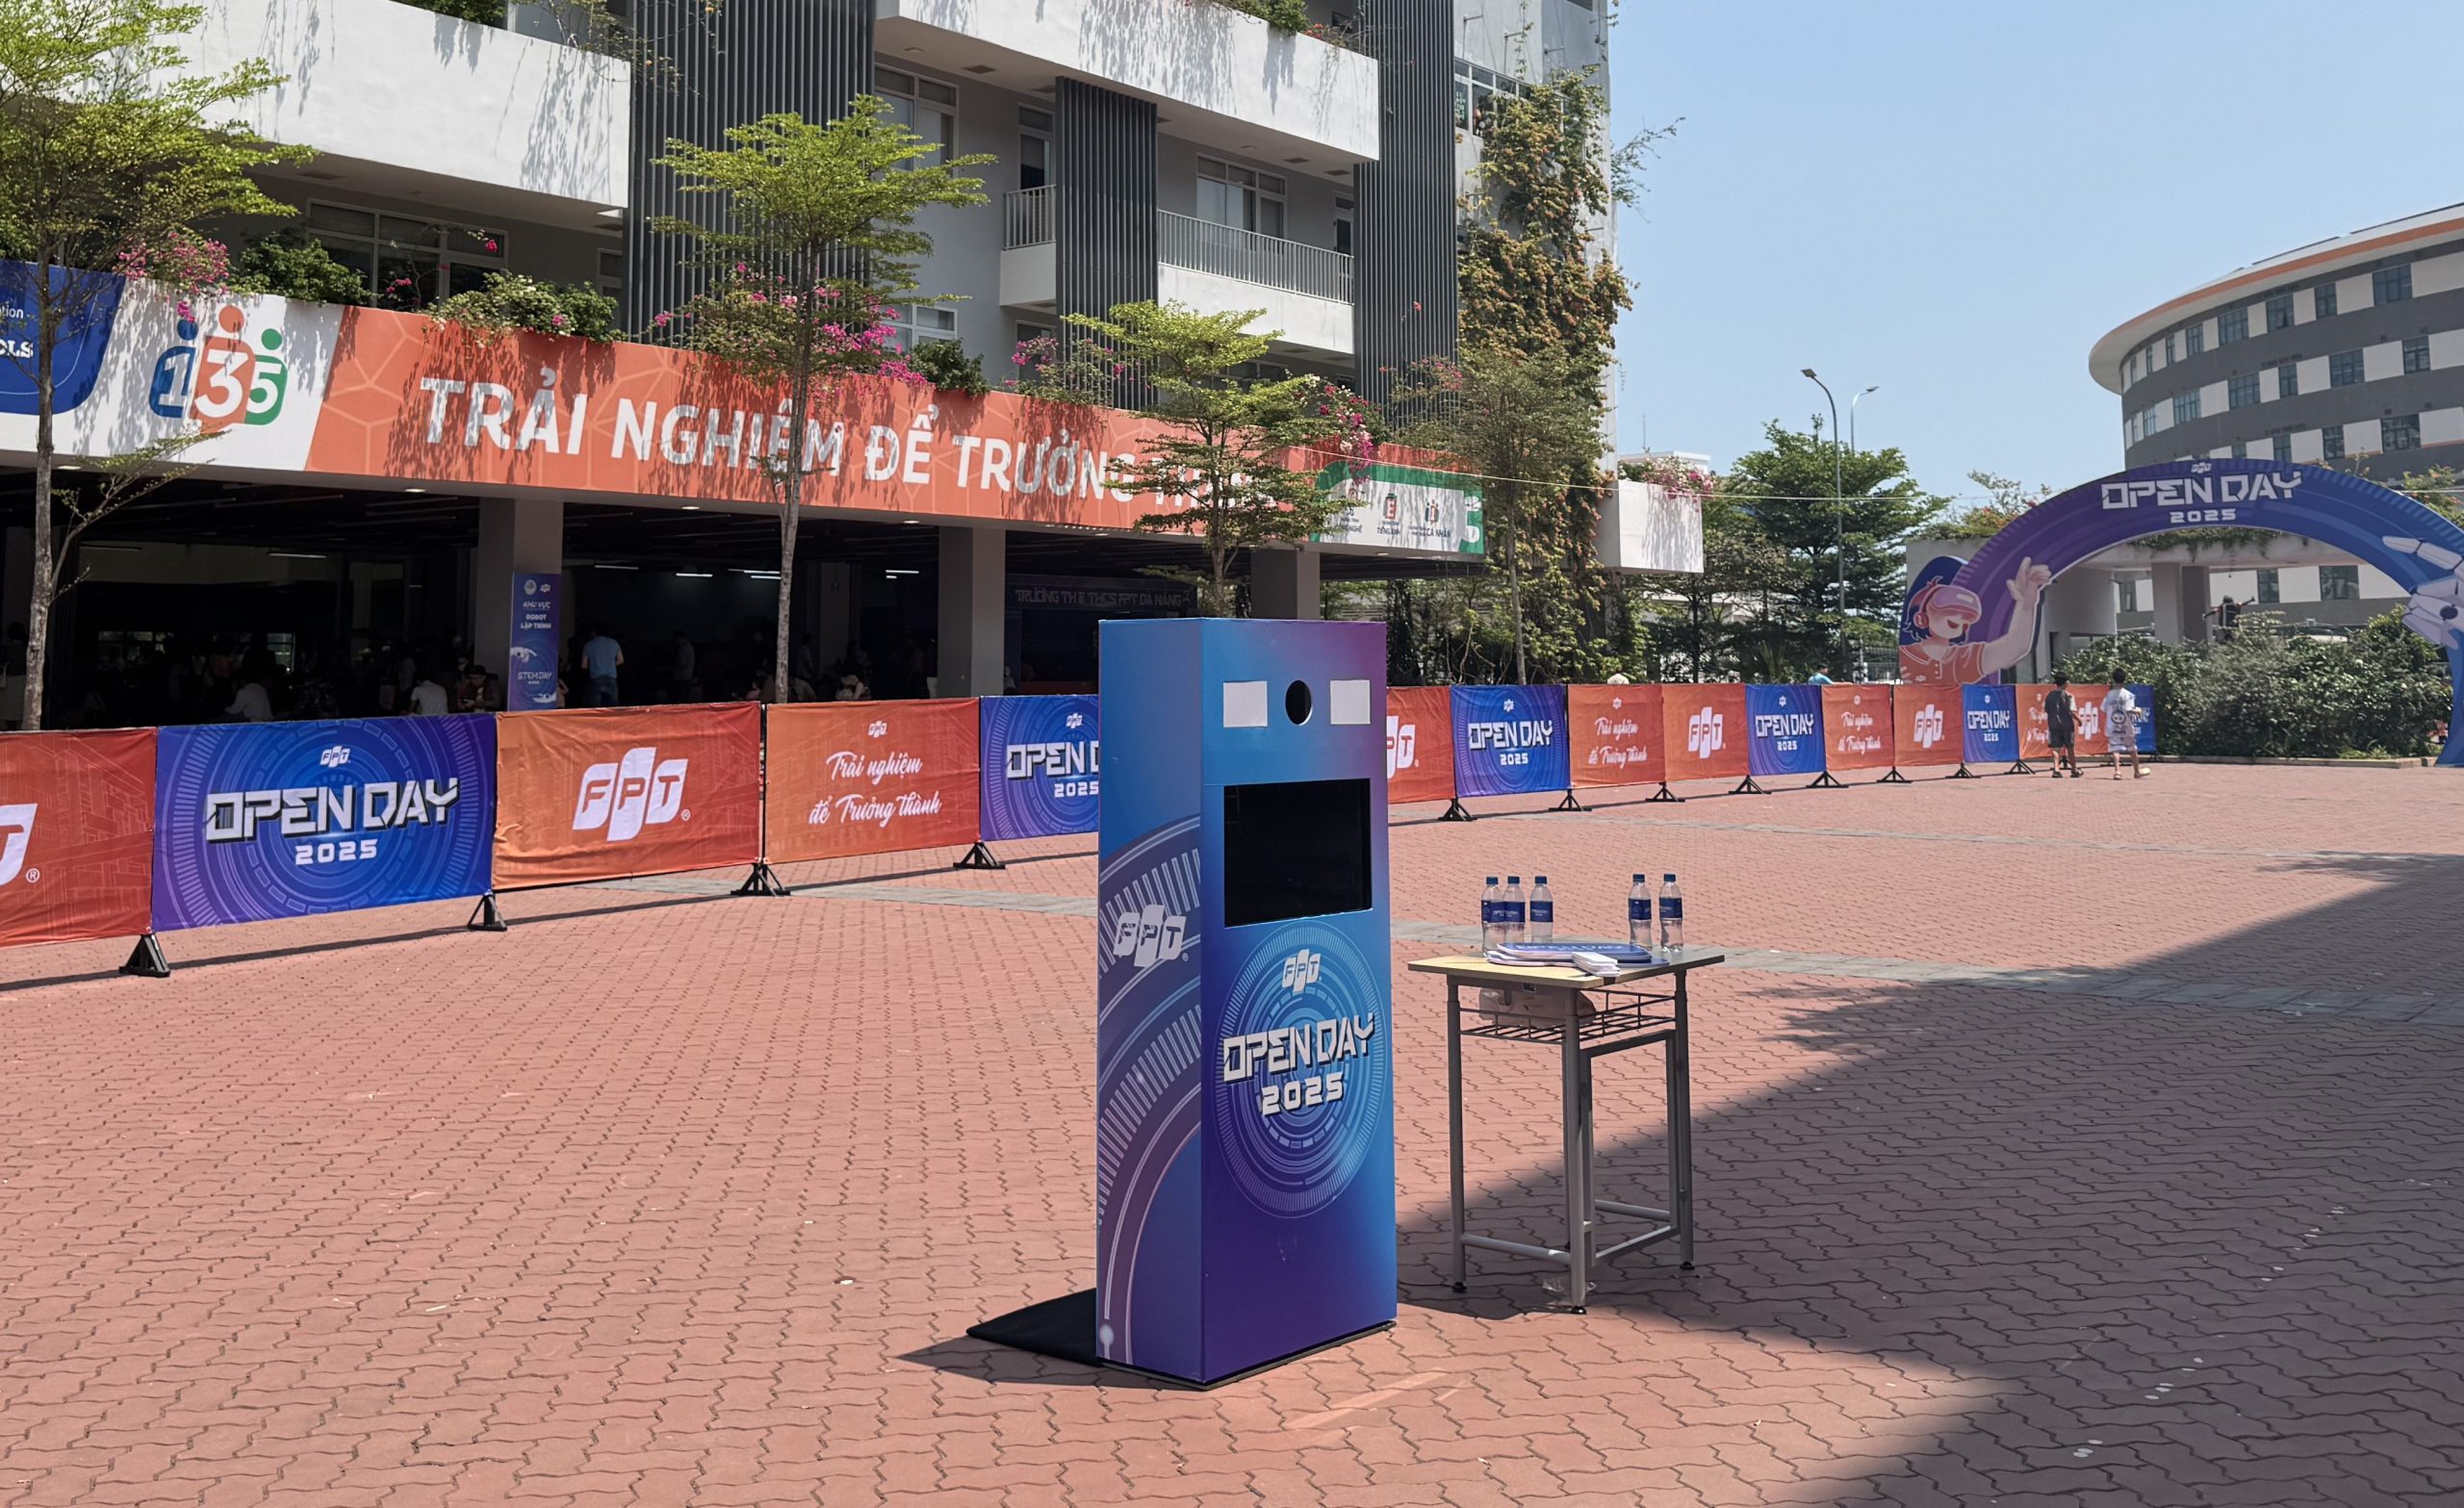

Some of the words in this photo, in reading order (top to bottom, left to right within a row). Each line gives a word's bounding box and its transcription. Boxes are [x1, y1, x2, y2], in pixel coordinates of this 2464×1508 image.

[421, 368, 587, 456] TRẢI
[865, 404, 939, 485] ĐỂ
[2101, 477, 2214, 510] OPEN
[2220, 471, 2303, 503] DAY
[2169, 508, 2237, 524] 2025
[1467, 722, 1518, 751] OPEN
[1520, 720, 1553, 747] DAY
[1688, 706, 1723, 759] FPT
[1755, 714, 1789, 738] OPEN
[1791, 713, 1814, 735] DAY
[1913, 703, 1943, 749] FPT
[1967, 711, 1992, 730] OPEN
[1993, 710, 2011, 728] DAY
[320, 745, 350, 768] FPT
[1006, 741, 1086, 779] OPEN
[1500, 753, 1529, 766] 2025
[1777, 740, 1798, 751] 2025
[826, 751, 865, 780] Trải
[866, 752, 923, 785] nghiệm
[573, 746, 689, 842] FPT
[1054, 780, 1099, 798] 2025
[205, 784, 355, 844] OPEN
[362, 777, 458, 829] DAY
[808, 795, 834, 825] để
[295, 838, 378, 866] 2025
[1114, 904, 1186, 968] FPT
[1282, 949, 1322, 995] FPT
[1223, 1023, 1311, 1084] OPEN
[1316, 1012, 1375, 1063] DAY
[1261, 1072, 1345, 1117] 2025
